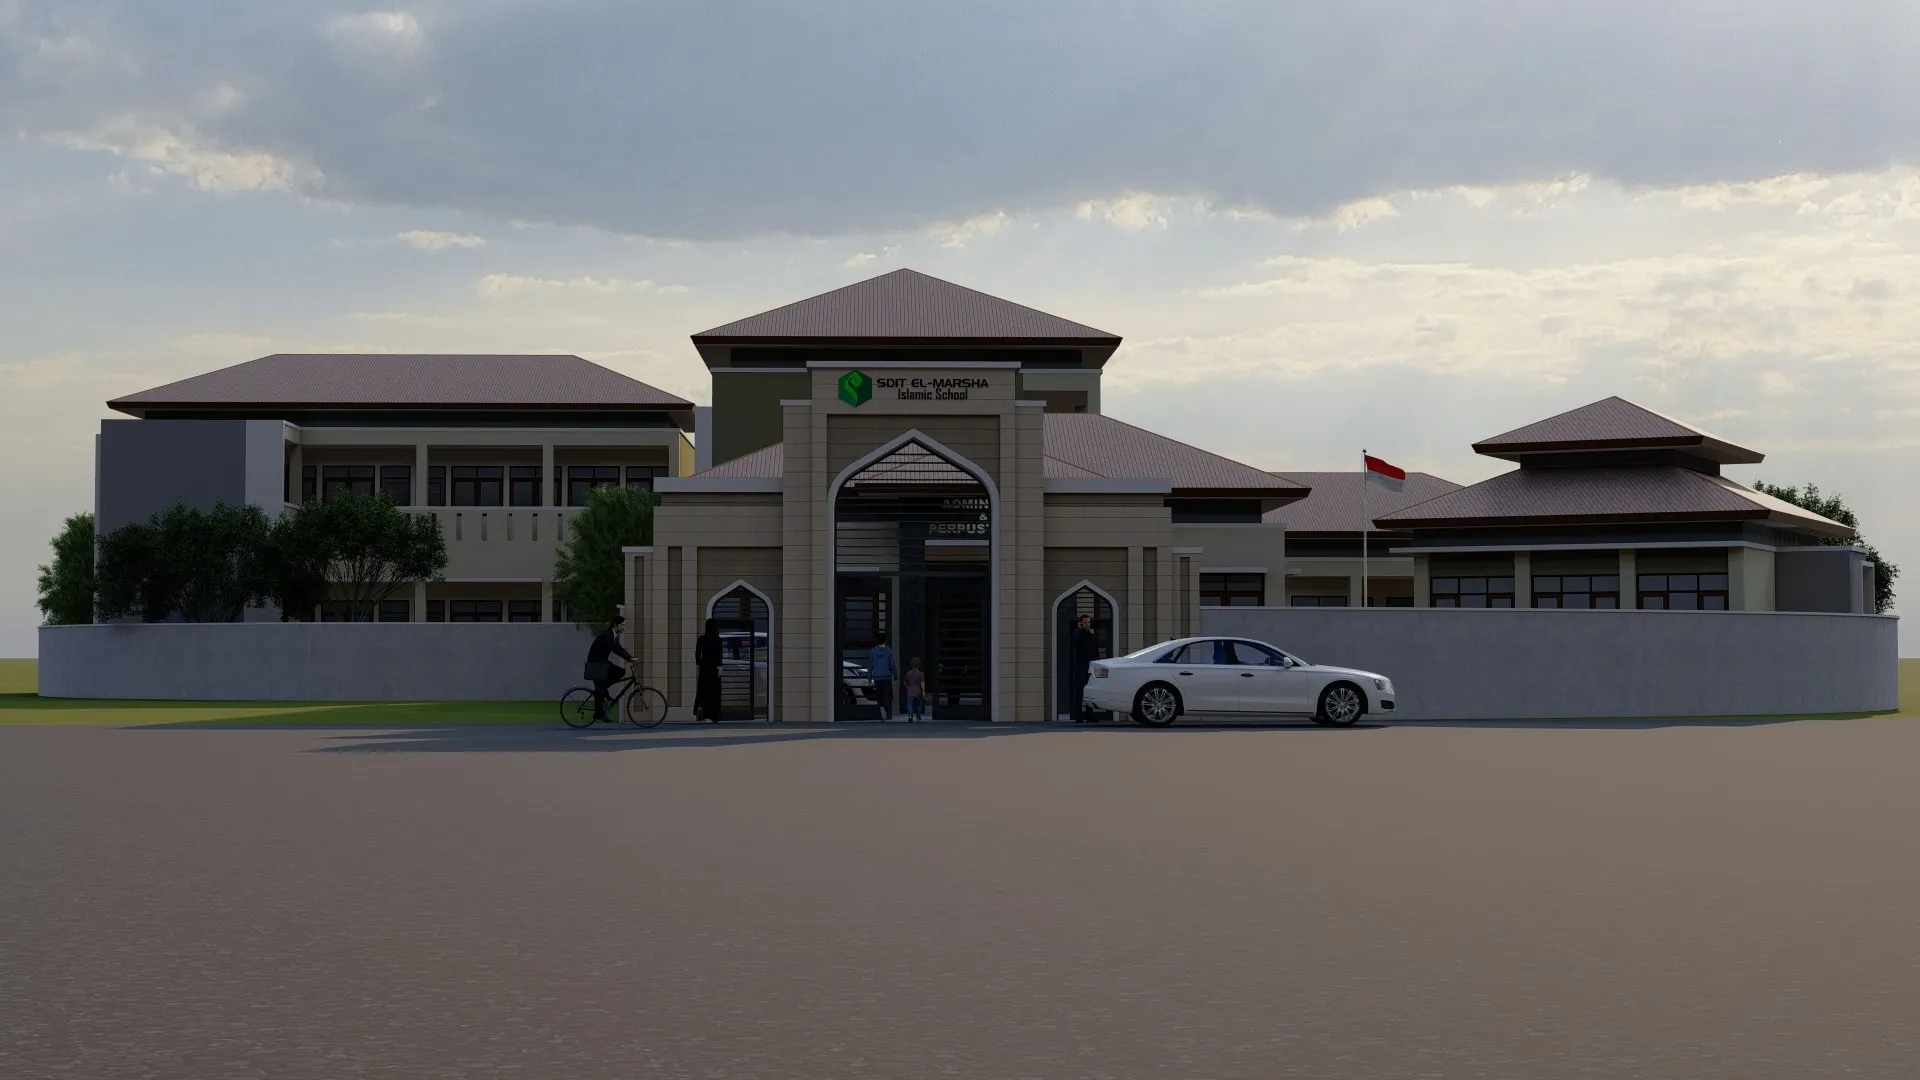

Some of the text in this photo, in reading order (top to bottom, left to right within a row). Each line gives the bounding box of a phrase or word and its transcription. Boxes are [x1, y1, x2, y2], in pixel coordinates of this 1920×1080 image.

[877, 379, 989, 388] SDIT EL-MARSHA
[898, 388, 968, 400] Islamic School
[942, 499, 989, 509] ADMIN
[979, 513, 988, 521] &
